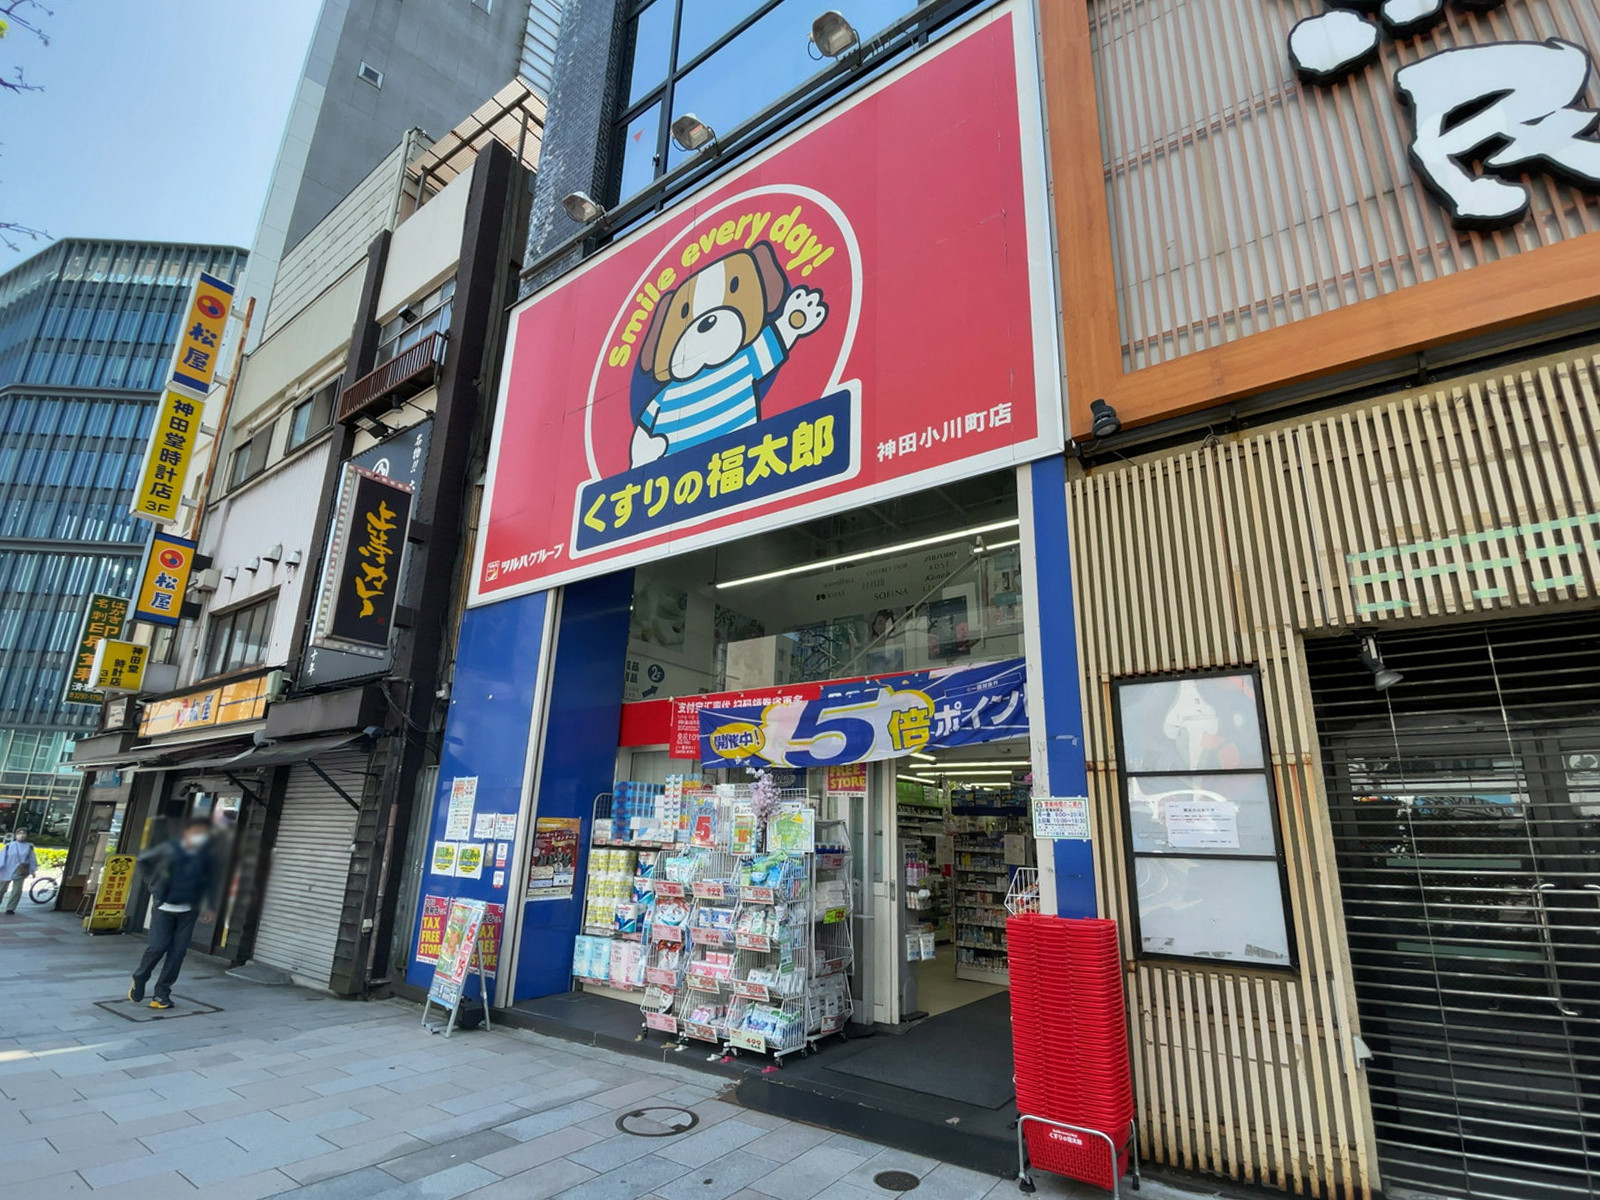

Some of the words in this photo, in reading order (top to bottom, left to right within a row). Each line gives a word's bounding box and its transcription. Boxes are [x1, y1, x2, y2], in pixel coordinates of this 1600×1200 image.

[608, 267, 677, 367] smile
[681, 211, 771, 268] every
[769, 205, 835, 277] day!
[183, 323, 218, 373] 松屋
[877, 402, 1012, 462] 神田小川町店
[150, 400, 195, 500] 神田堂時計店
[583, 415, 834, 532] くすりの福太郎
[145, 501, 169, 513] 3F
[501, 543, 564, 574] ツルハグループ
[150, 572, 178, 611] 松屋
[873, 588, 909, 600] SOFINA
[110, 659, 125, 686] 時計店
[128, 647, 143, 673] 神田堂
[888, 706, 931, 750] 倍
[830, 776, 866, 789] STORE
[695, 816, 712, 842] 5
[423, 917, 440, 929] TAX
[479, 925, 495, 938] AX
[421, 931, 441, 943] FREE
[472, 954, 497, 966] SORE
